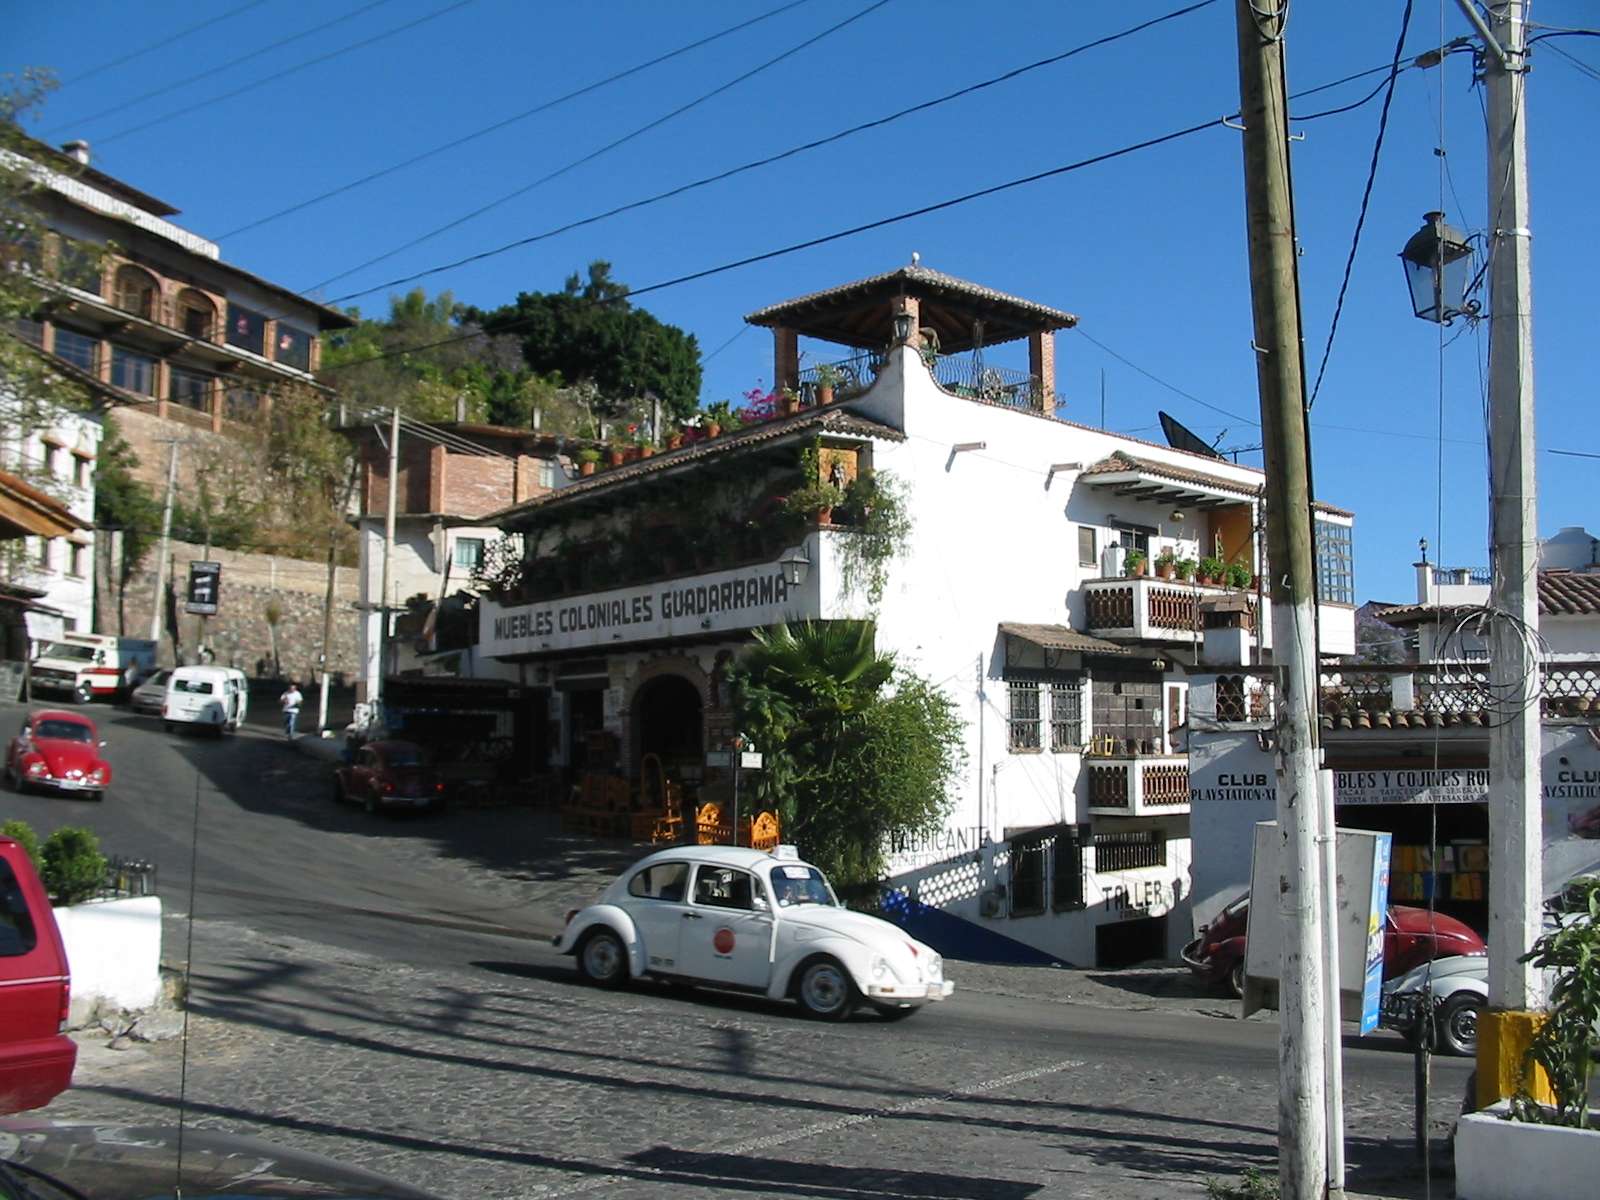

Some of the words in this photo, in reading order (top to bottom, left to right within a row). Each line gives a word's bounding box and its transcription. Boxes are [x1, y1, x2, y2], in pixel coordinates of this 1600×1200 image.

[494, 610, 553, 641] MUEBLES
[558, 595, 654, 633] COLONIALES
[661, 573, 788, 619] GUADARRAMA
[1218, 774, 1267, 786] CLUB
[1333, 772, 1376, 789] BLES
[1381, 771, 1391, 788] Y
[1396, 769, 1460, 788] COJINES
[1558, 770, 1600, 783] CLU
[1102, 880, 1162, 912] TALLER
